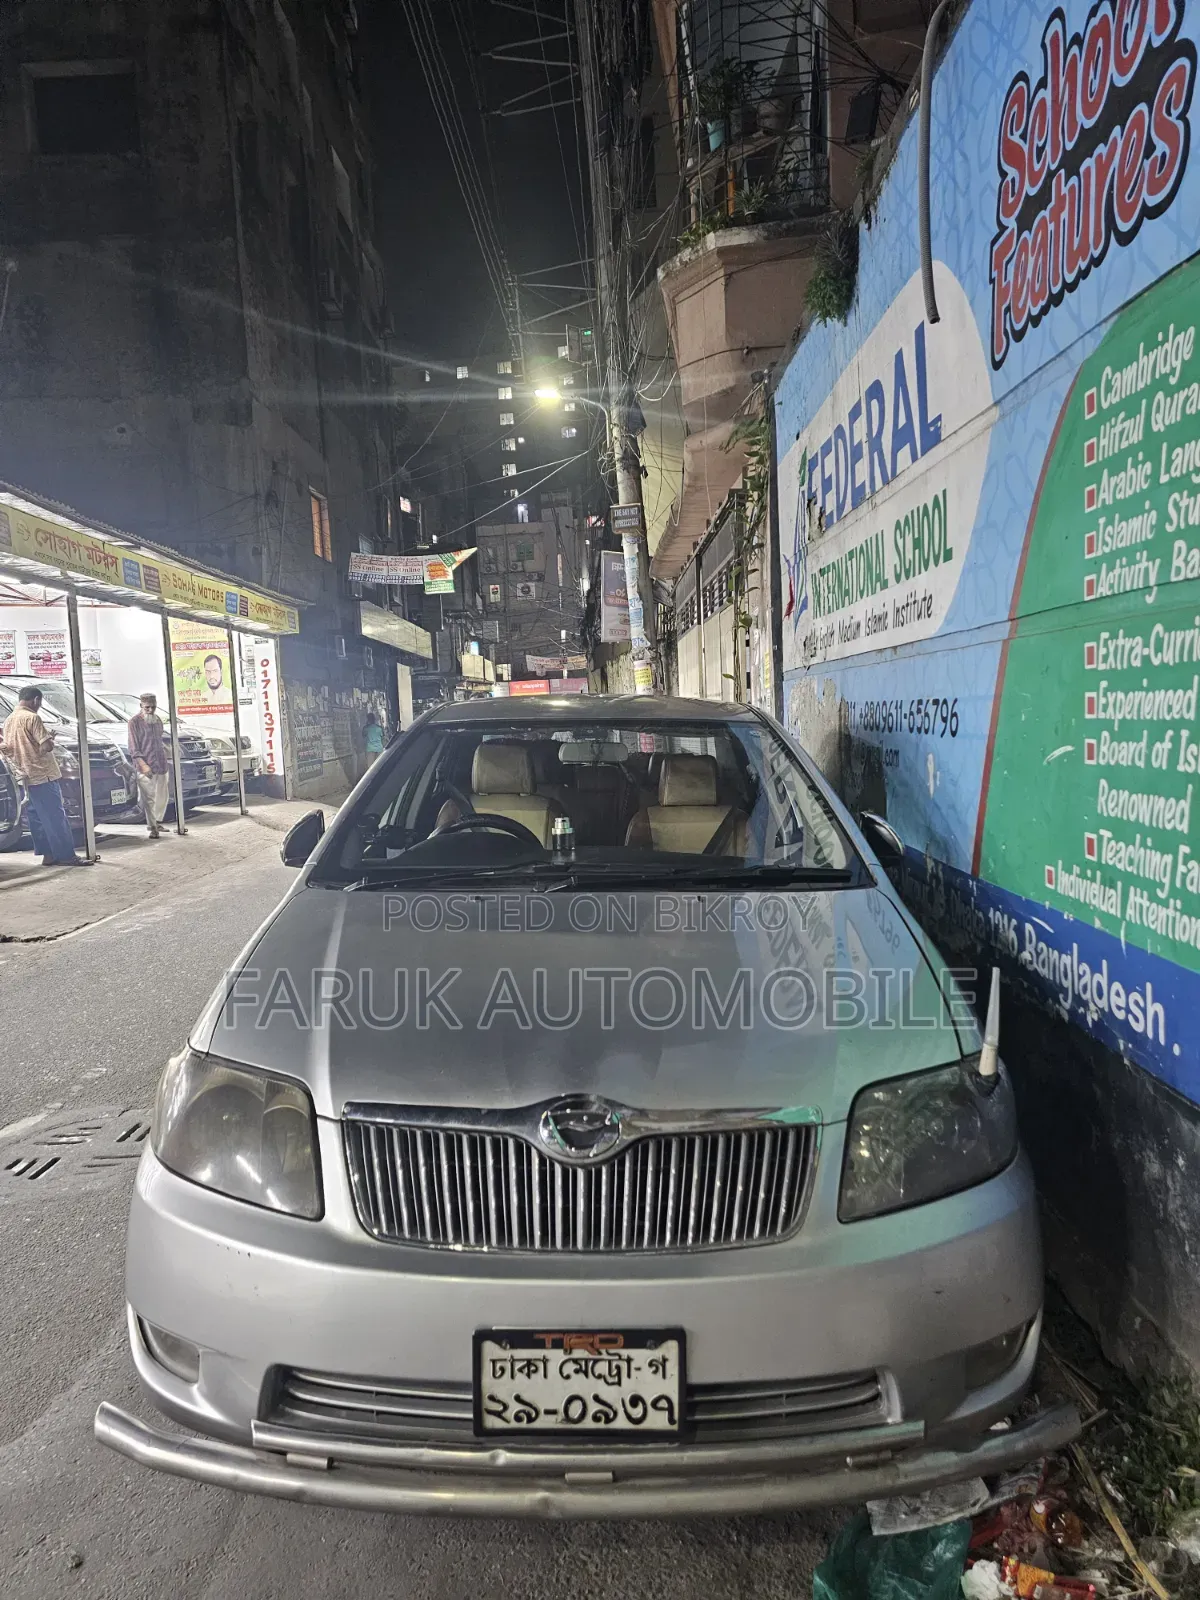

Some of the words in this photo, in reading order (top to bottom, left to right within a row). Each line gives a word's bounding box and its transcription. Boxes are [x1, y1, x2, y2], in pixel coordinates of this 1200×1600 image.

[999, 0, 1174, 219] Schoo
[991, 57, 1190, 359] Features
[1100, 323, 1196, 410] Cambridge
[807, 319, 943, 532] FEDERAL
[1098, 398, 1147, 462] Hifzul
[1097, 451, 1152, 509] Arabic
[811, 529, 889, 621] INTERNATIONAL
[893, 488, 954, 585] SCHOOL
[1096, 499, 1158, 558] Islamic
[1094, 549, 1161, 604] Activity
[838, 614, 862, 646] Medium
[864, 601, 889, 638] Islamic
[892, 587, 934, 631] Institute
[1097, 615, 1200, 672] Extra-Curri
[259, 658, 277, 786] 0171137115
[859, 697, 960, 739] +8809611-656796
[1097, 674, 1199, 731] Experienced
[1098, 729, 1149, 769] Board
[1151, 729, 1173, 770] of
[1176, 728, 1200, 774] Is
[1097, 778, 1194, 835] Renowned
[1056, 859, 1122, 920] Individual
[1098, 828, 1173, 899] Teaching
[1175, 844, 1200, 894] Fa
[489, 1354, 550, 1381] ঢাকা
[483, 1393, 678, 1426] ২৯-০৯৩৭
